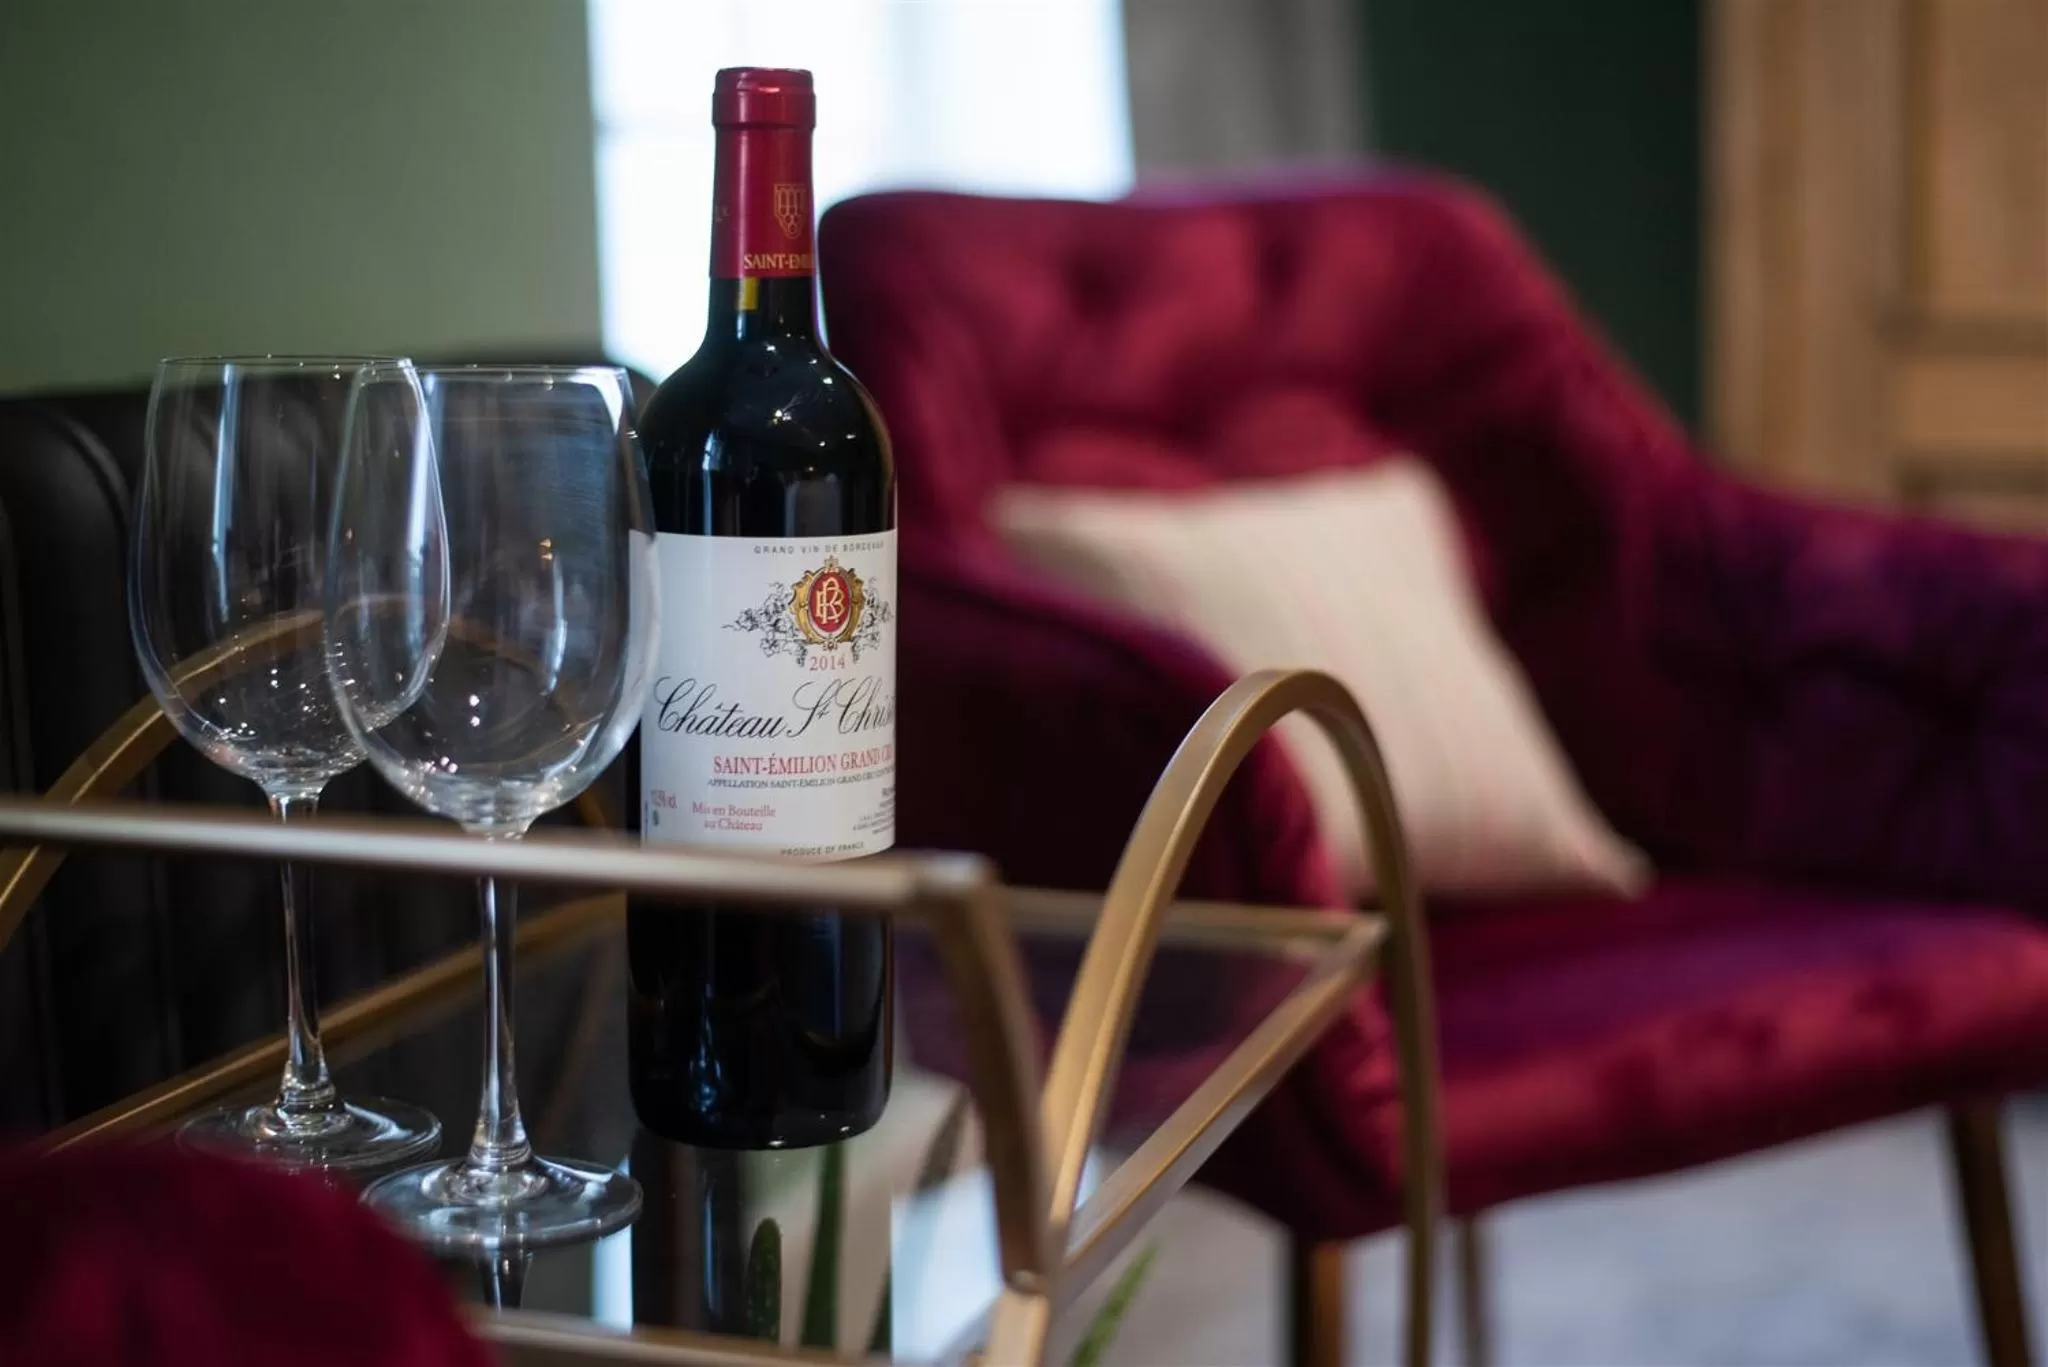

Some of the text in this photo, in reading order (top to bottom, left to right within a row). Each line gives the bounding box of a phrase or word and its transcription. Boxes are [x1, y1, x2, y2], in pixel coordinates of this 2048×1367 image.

[753, 545, 795, 554] GRAND
[801, 545, 820, 553] VIN
[825, 544, 841, 553] DE
[809, 655, 846, 671] 2014
[653, 675, 788, 738] Château
[713, 752, 837, 776] SAINT-ÉMILION
[840, 748, 881, 770] GRAND
[707, 778, 768, 789] APPELLATION
[692, 801, 776, 818] Mis en Bouteille
[704, 817, 763, 832] au Château
[780, 841, 865, 857] PRODUCE OF FRANCE
